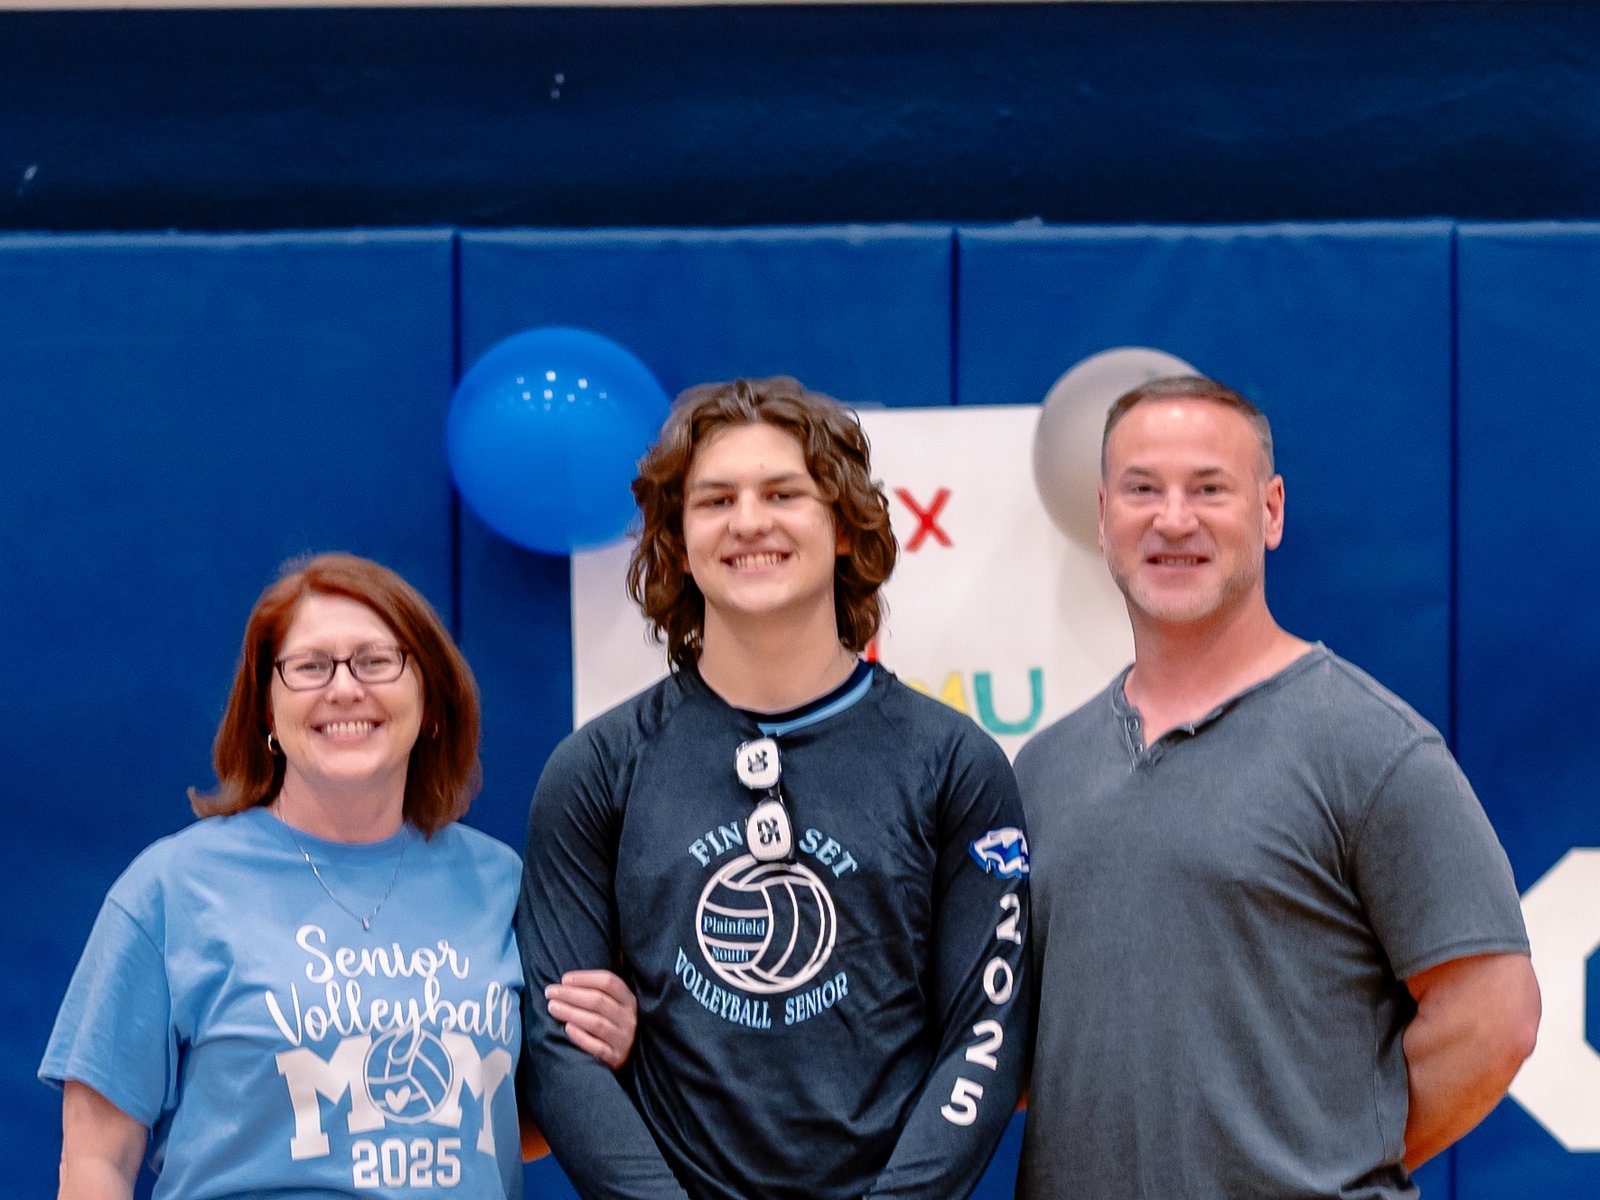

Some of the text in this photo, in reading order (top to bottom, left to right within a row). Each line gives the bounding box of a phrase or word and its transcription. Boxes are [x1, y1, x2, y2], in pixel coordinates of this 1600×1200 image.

[799, 827, 858, 878] SET
[703, 915, 765, 937] Plainfield
[295, 923, 470, 984] Senior
[711, 946, 749, 962] South
[674, 946, 849, 1029] VOLLEYBALL SENIOR
[264, 976, 515, 1065] Volleyball
[351, 1137, 462, 1190] 2025
